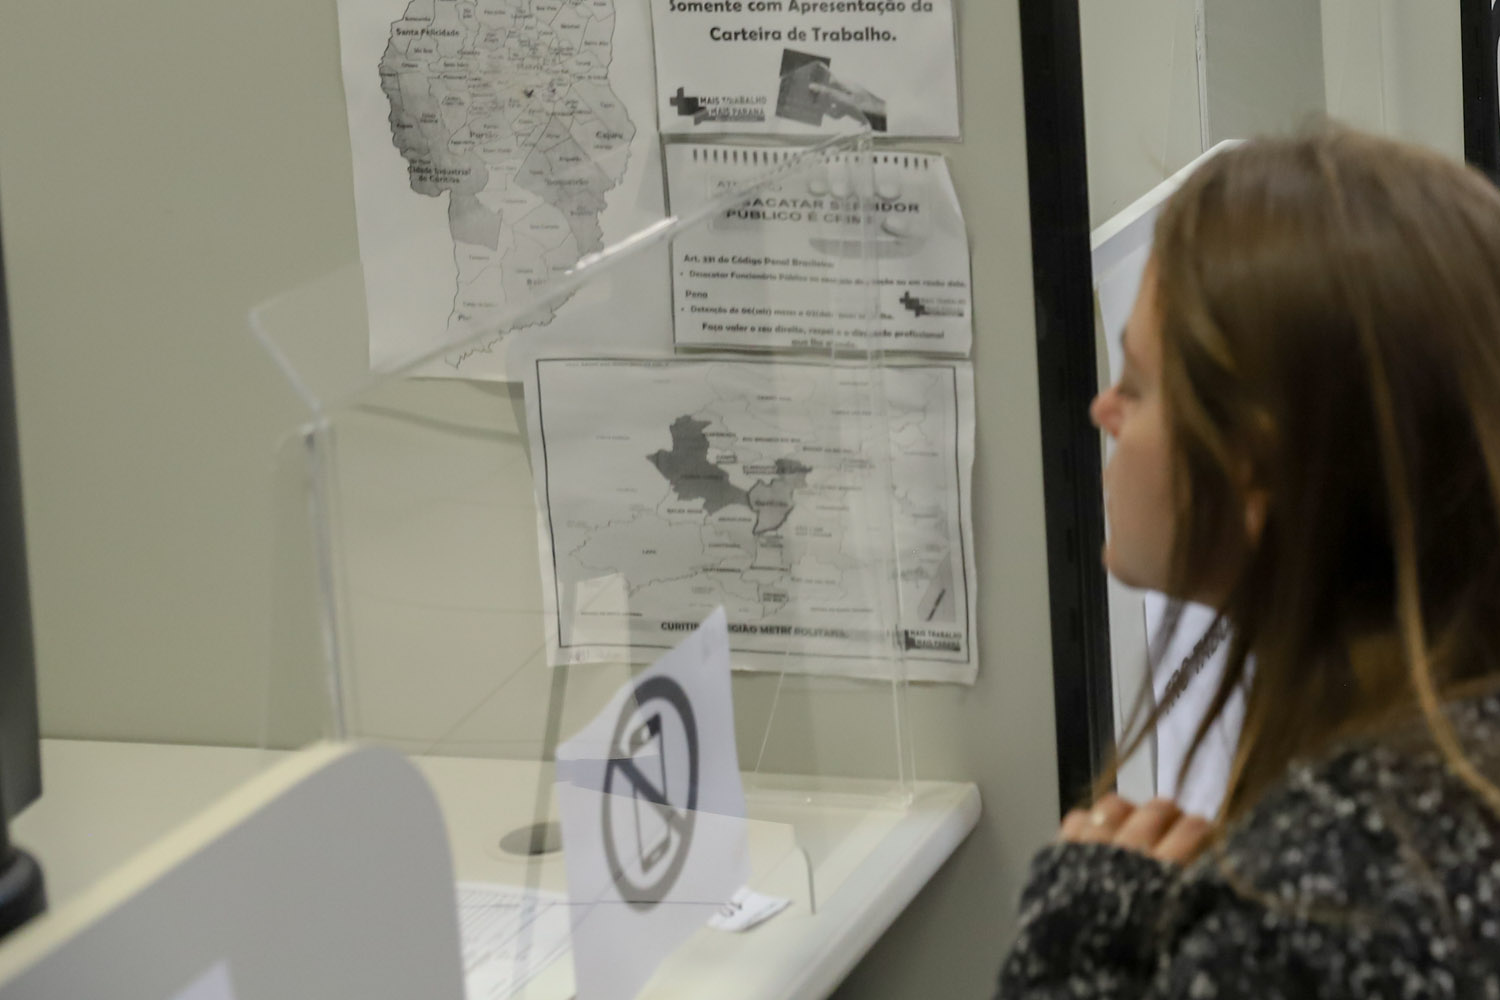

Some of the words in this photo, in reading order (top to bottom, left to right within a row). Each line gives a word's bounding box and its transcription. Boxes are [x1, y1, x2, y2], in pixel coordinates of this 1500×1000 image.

[747, 0, 783, 12] com
[911, 0, 933, 13] da
[710, 27, 782, 42] Carteira
[787, 27, 807, 41] de
[811, 27, 897, 42] Trabalho.
[742, 197, 823, 210] ACATAR
